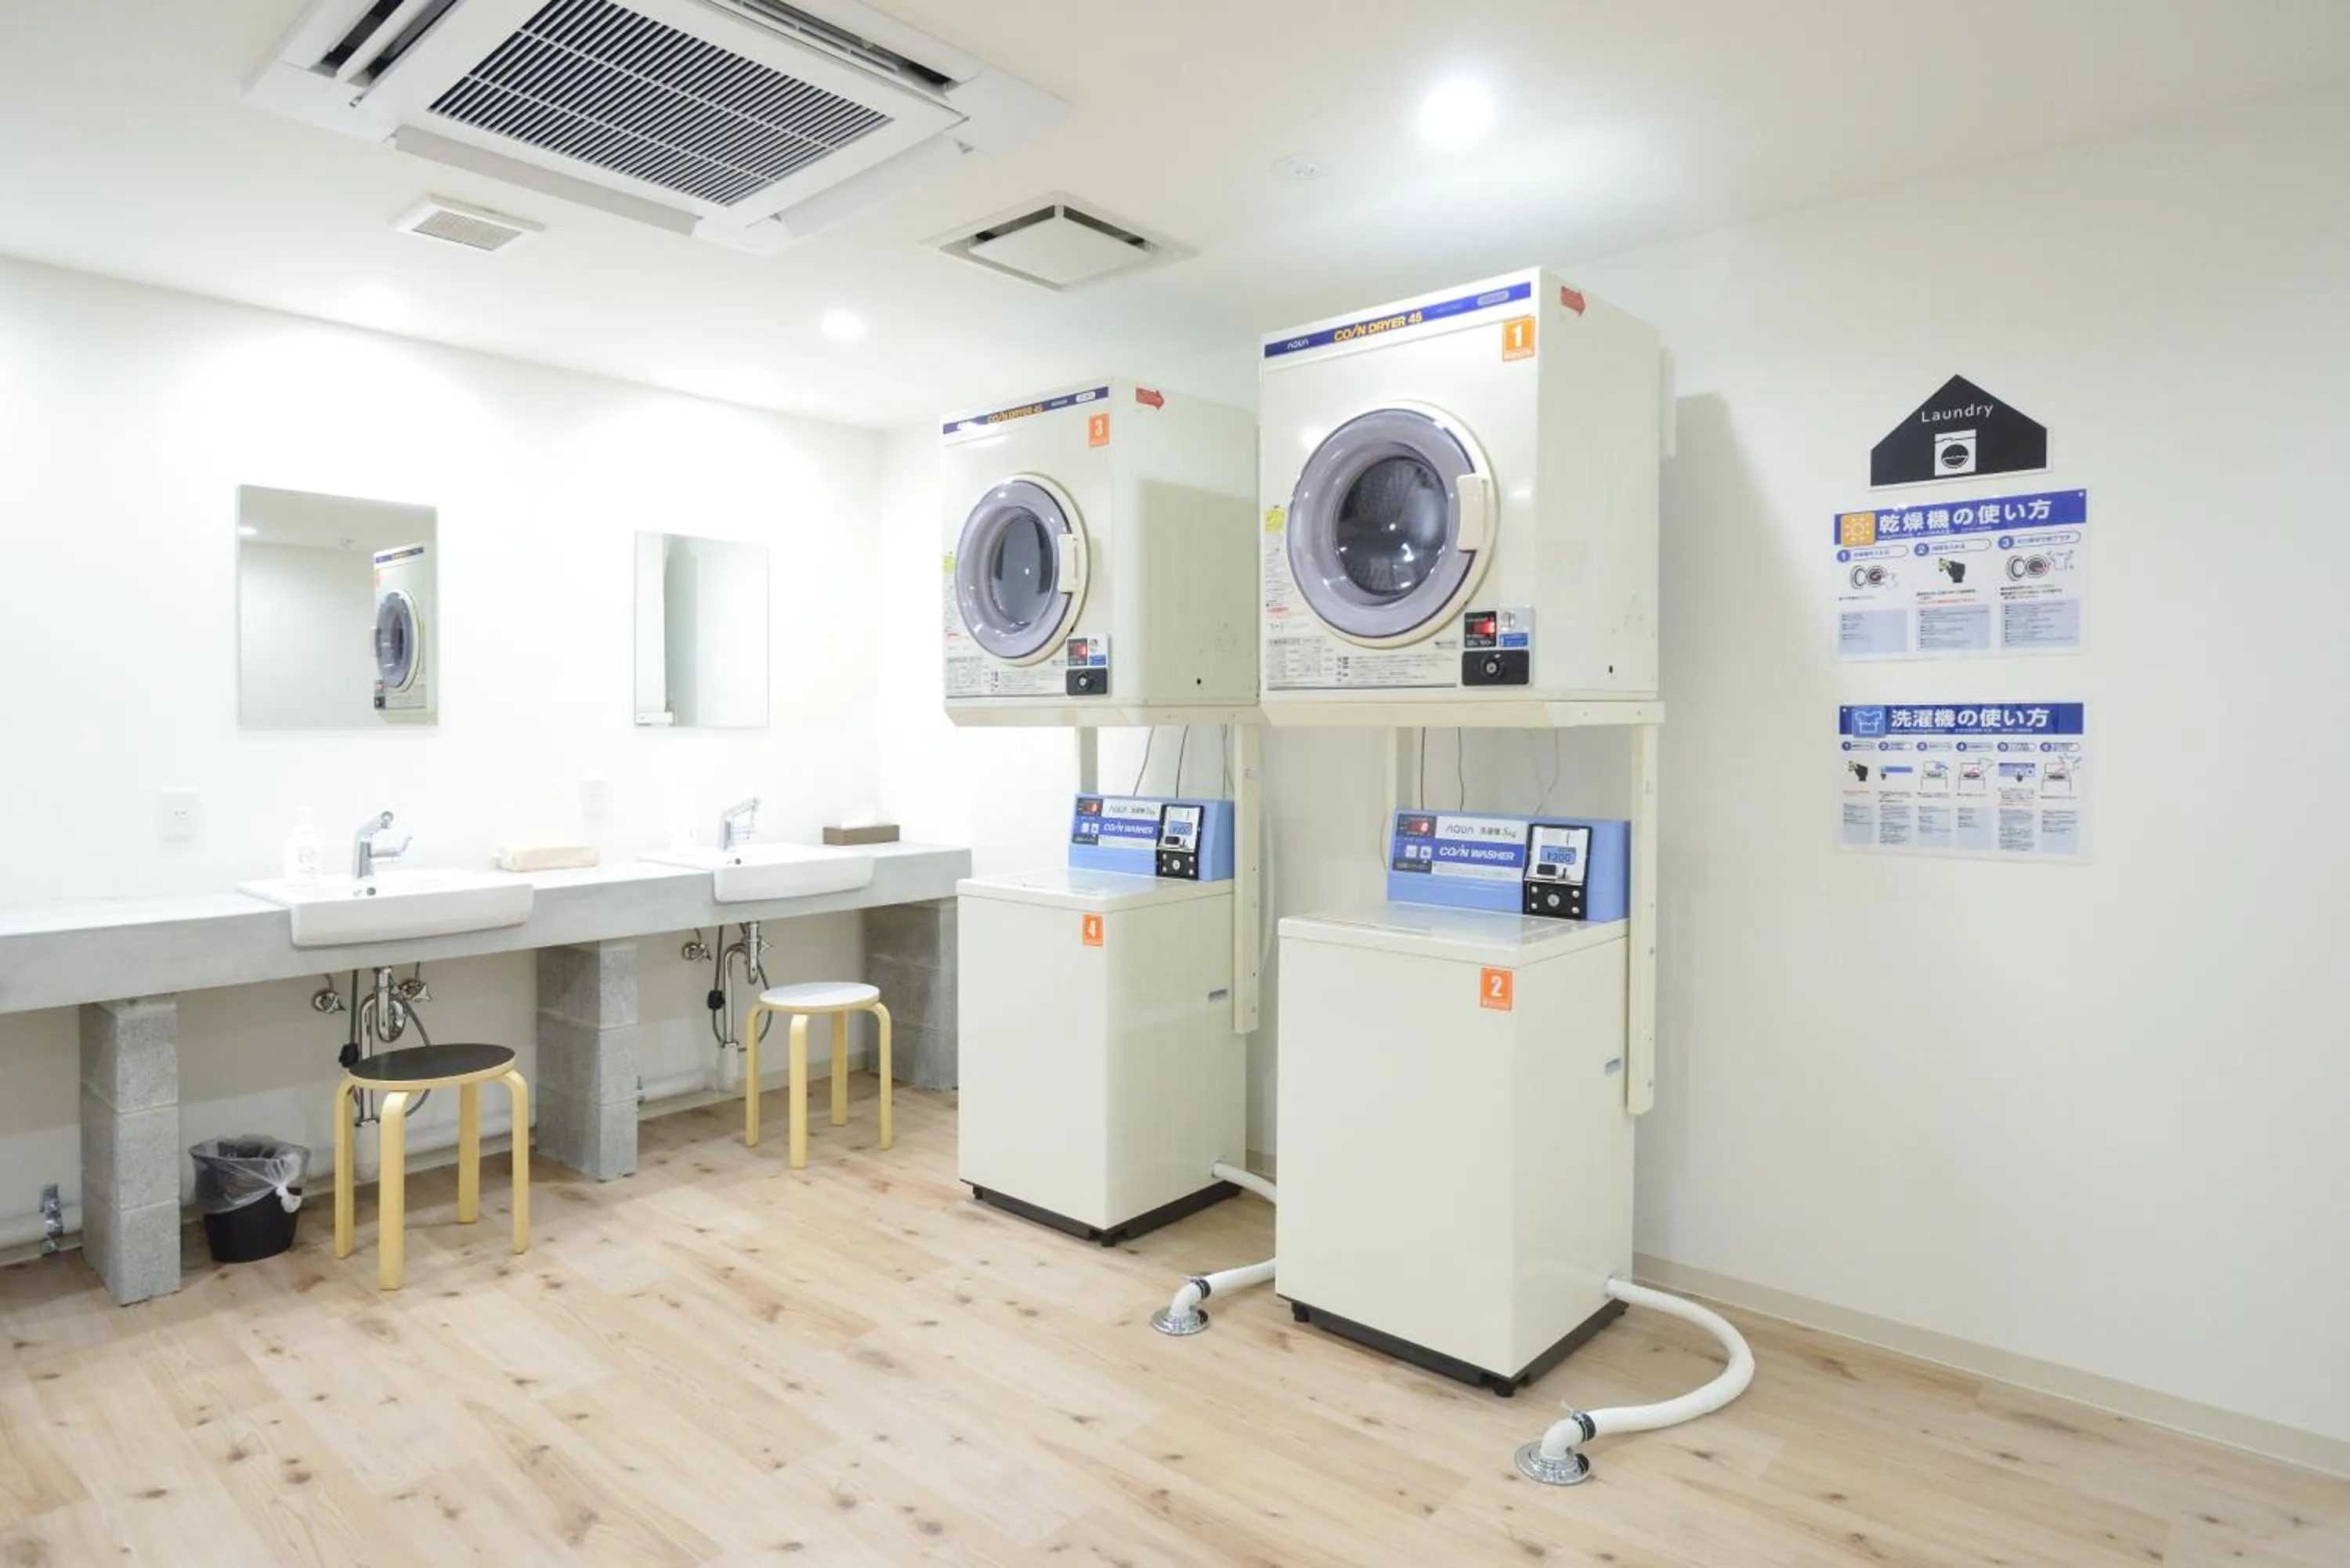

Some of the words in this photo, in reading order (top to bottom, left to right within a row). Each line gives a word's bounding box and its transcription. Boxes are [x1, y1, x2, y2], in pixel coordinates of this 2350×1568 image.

[1368, 316, 1406, 334] DRYER
[1408, 312, 1423, 324] 45
[1513, 326, 1522, 347] 1
[1921, 403, 1994, 423] Laundry
[1095, 419, 1103, 436] 3
[1879, 499, 2052, 533] 乾燥機の使い方
[1890, 707, 2050, 728] 洗濯機の使い方
[1470, 848, 1516, 861] WASHER
[1087, 920, 1096, 938] 4
[1491, 975, 1503, 997] 2
